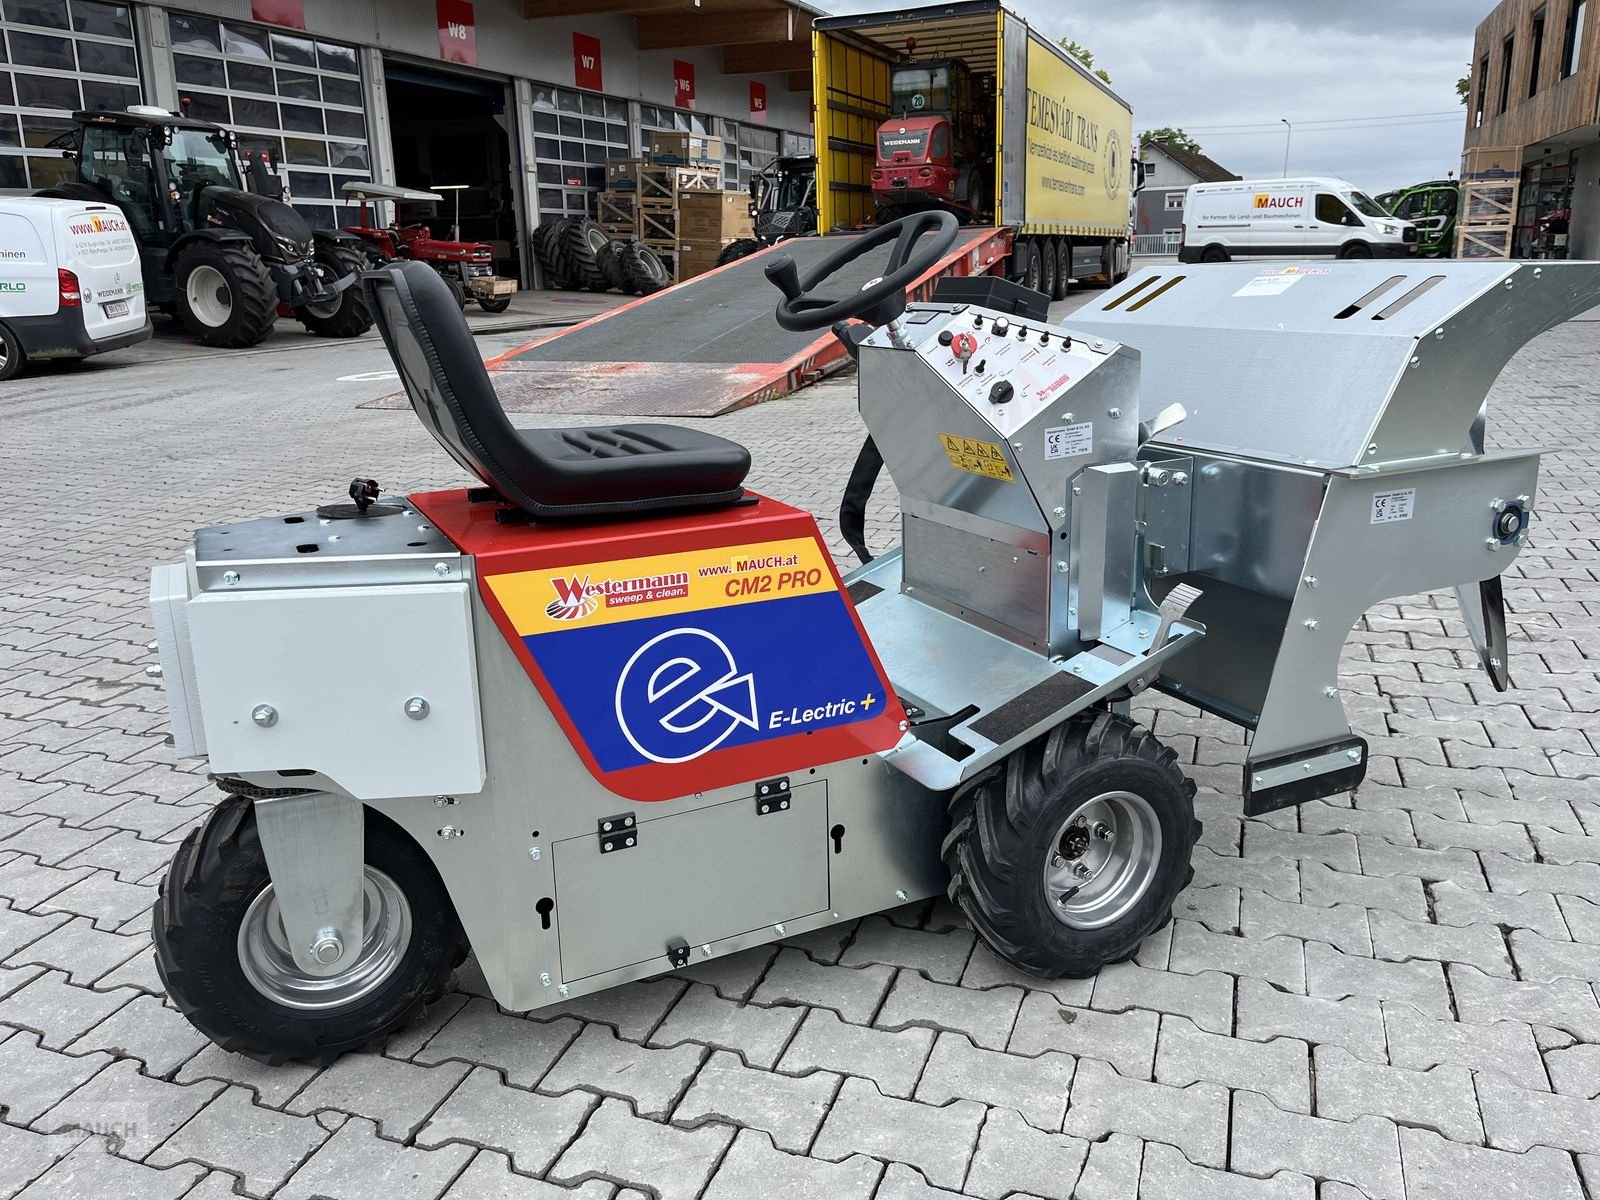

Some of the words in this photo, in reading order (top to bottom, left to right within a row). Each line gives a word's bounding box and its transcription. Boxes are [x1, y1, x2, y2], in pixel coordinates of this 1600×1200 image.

[447, 21, 467, 40] W8
[581, 54, 595, 70] W7
[679, 78, 691, 92] W6
[753, 98, 763, 109] W5
[884, 138, 920, 146] WEIDEMANN
[1076, 115, 1099, 153] TRANS
[1256, 196, 1304, 209] MAUCH
[551, 572, 688, 606] Westermann
[725, 574, 772, 598] CM2
[777, 568, 822, 591] PRO
[609, 593, 643, 605] sweep
[646, 590, 654, 600] &
[656, 586, 687, 598] clean.
[768, 697, 856, 730] E-Lectric
